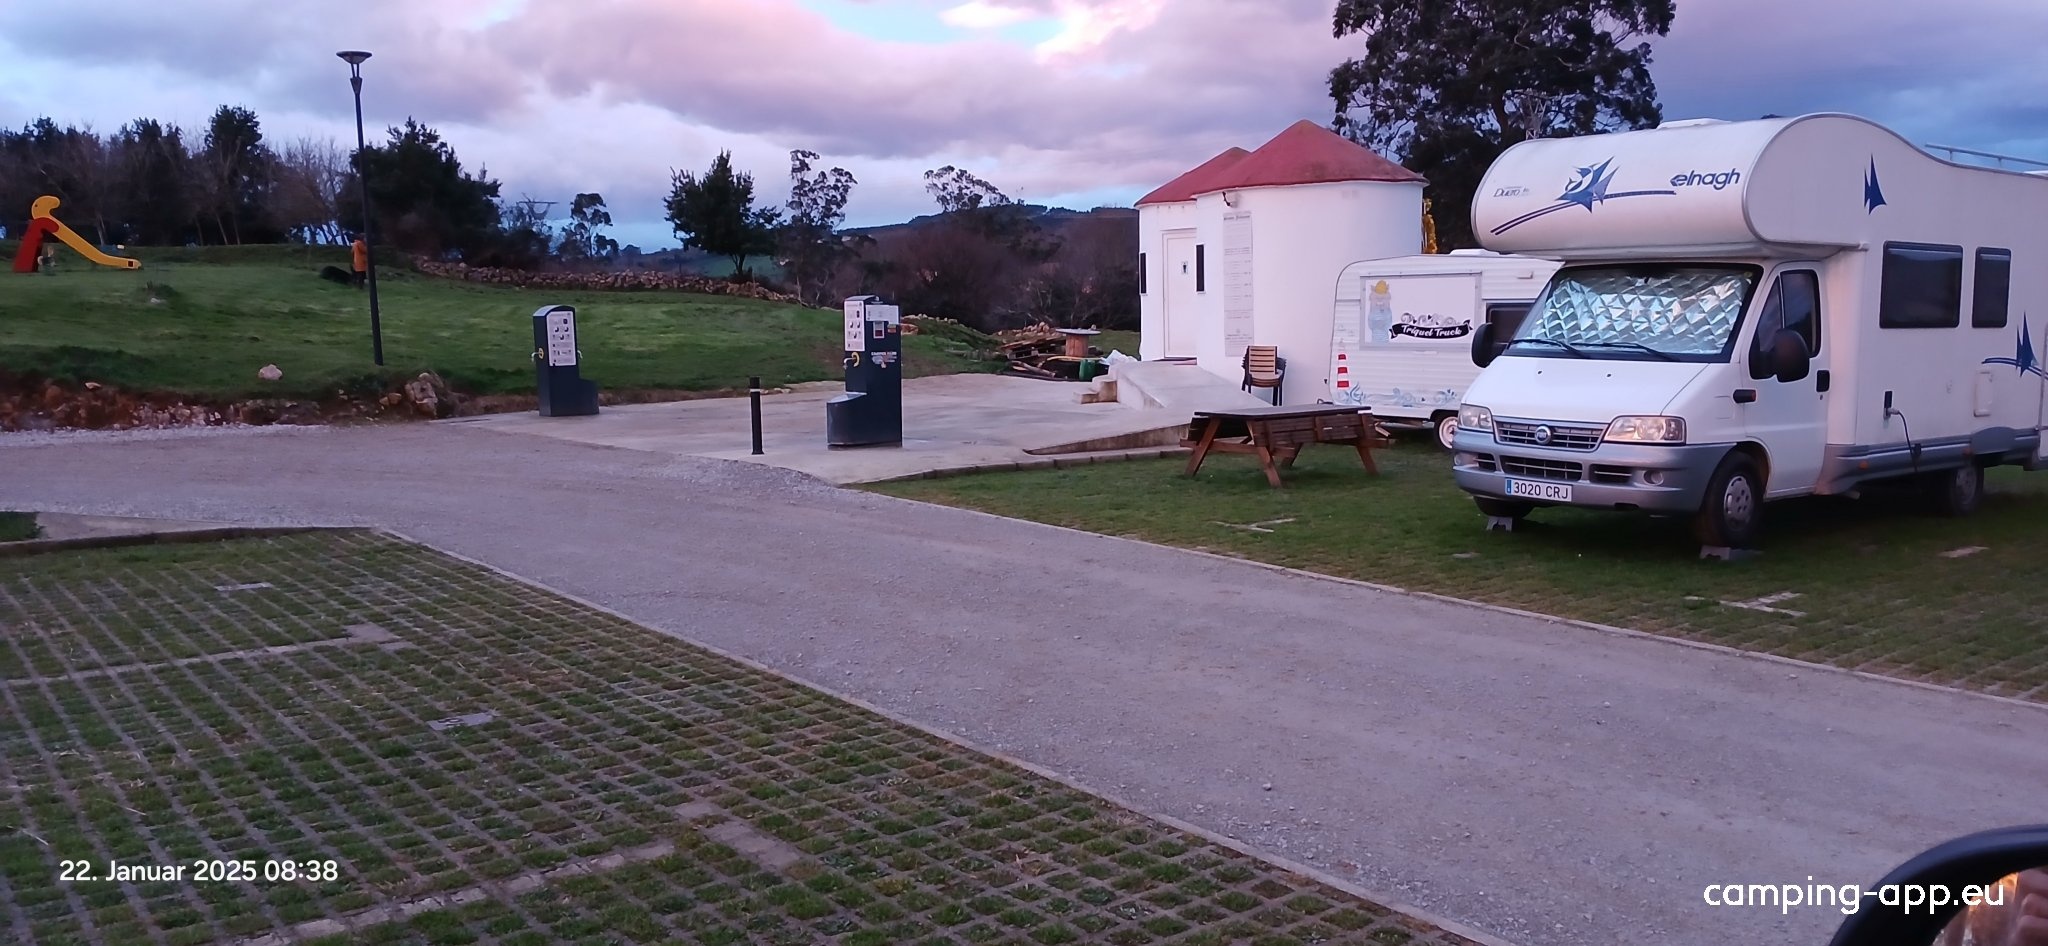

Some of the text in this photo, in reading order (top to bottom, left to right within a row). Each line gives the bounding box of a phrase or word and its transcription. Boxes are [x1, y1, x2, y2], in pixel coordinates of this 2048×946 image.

[1670, 168, 1741, 190] elnagh
[1434, 327, 1462, 337] Truck
[1514, 481, 1568, 499] 3020 CRJ
